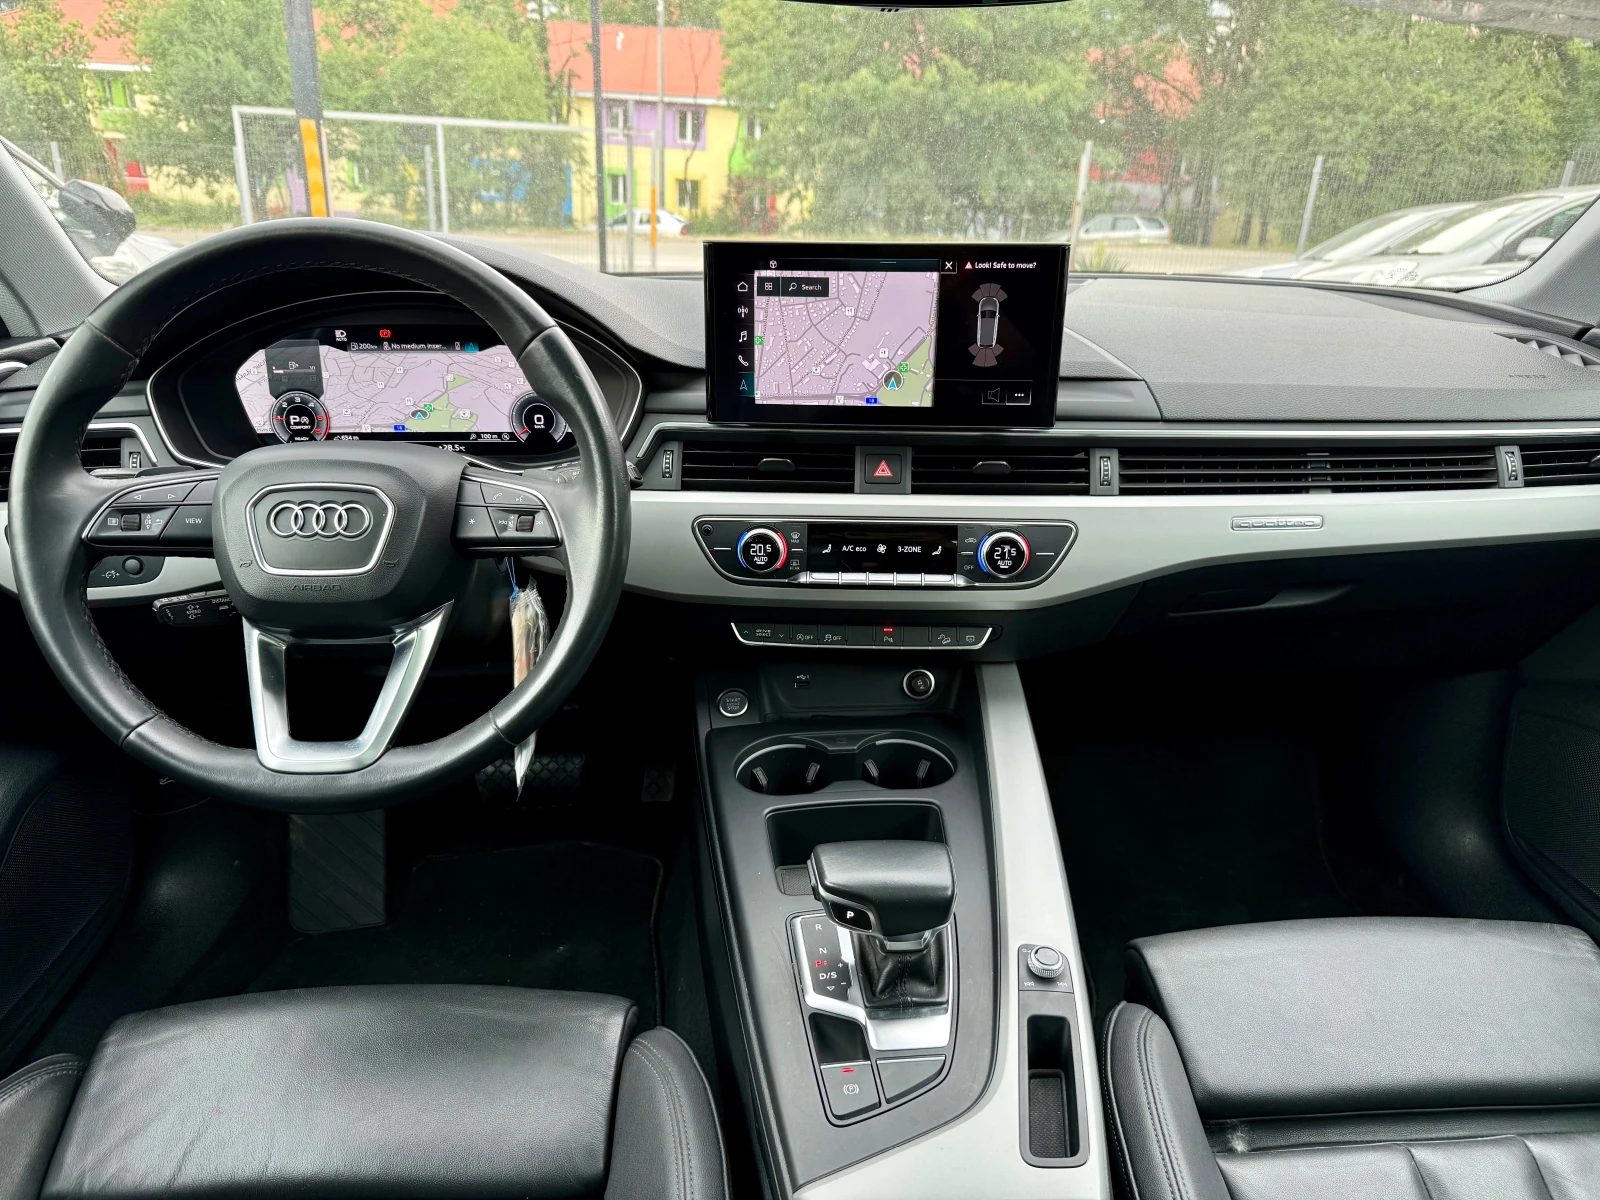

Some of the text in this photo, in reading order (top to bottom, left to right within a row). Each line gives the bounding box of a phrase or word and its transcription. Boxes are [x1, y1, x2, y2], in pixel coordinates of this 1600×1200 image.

[974, 261, 1037, 269] Look! Safe to move?
[391, 342, 401, 350] No
[401, 342, 425, 350] medium
[289, 415, 299, 426] P
[533, 414, 544, 425] 0
[1239, 520, 1316, 529] quattro
[841, 544, 854, 552] A/C
[897, 545, 922, 553] 3-ZONE
[291, 583, 342, 592] AIRBAG
[846, 911, 855, 919] P
[815, 923, 823, 931] R
[819, 946, 827, 955] N
[819, 971, 838, 980] D/S
